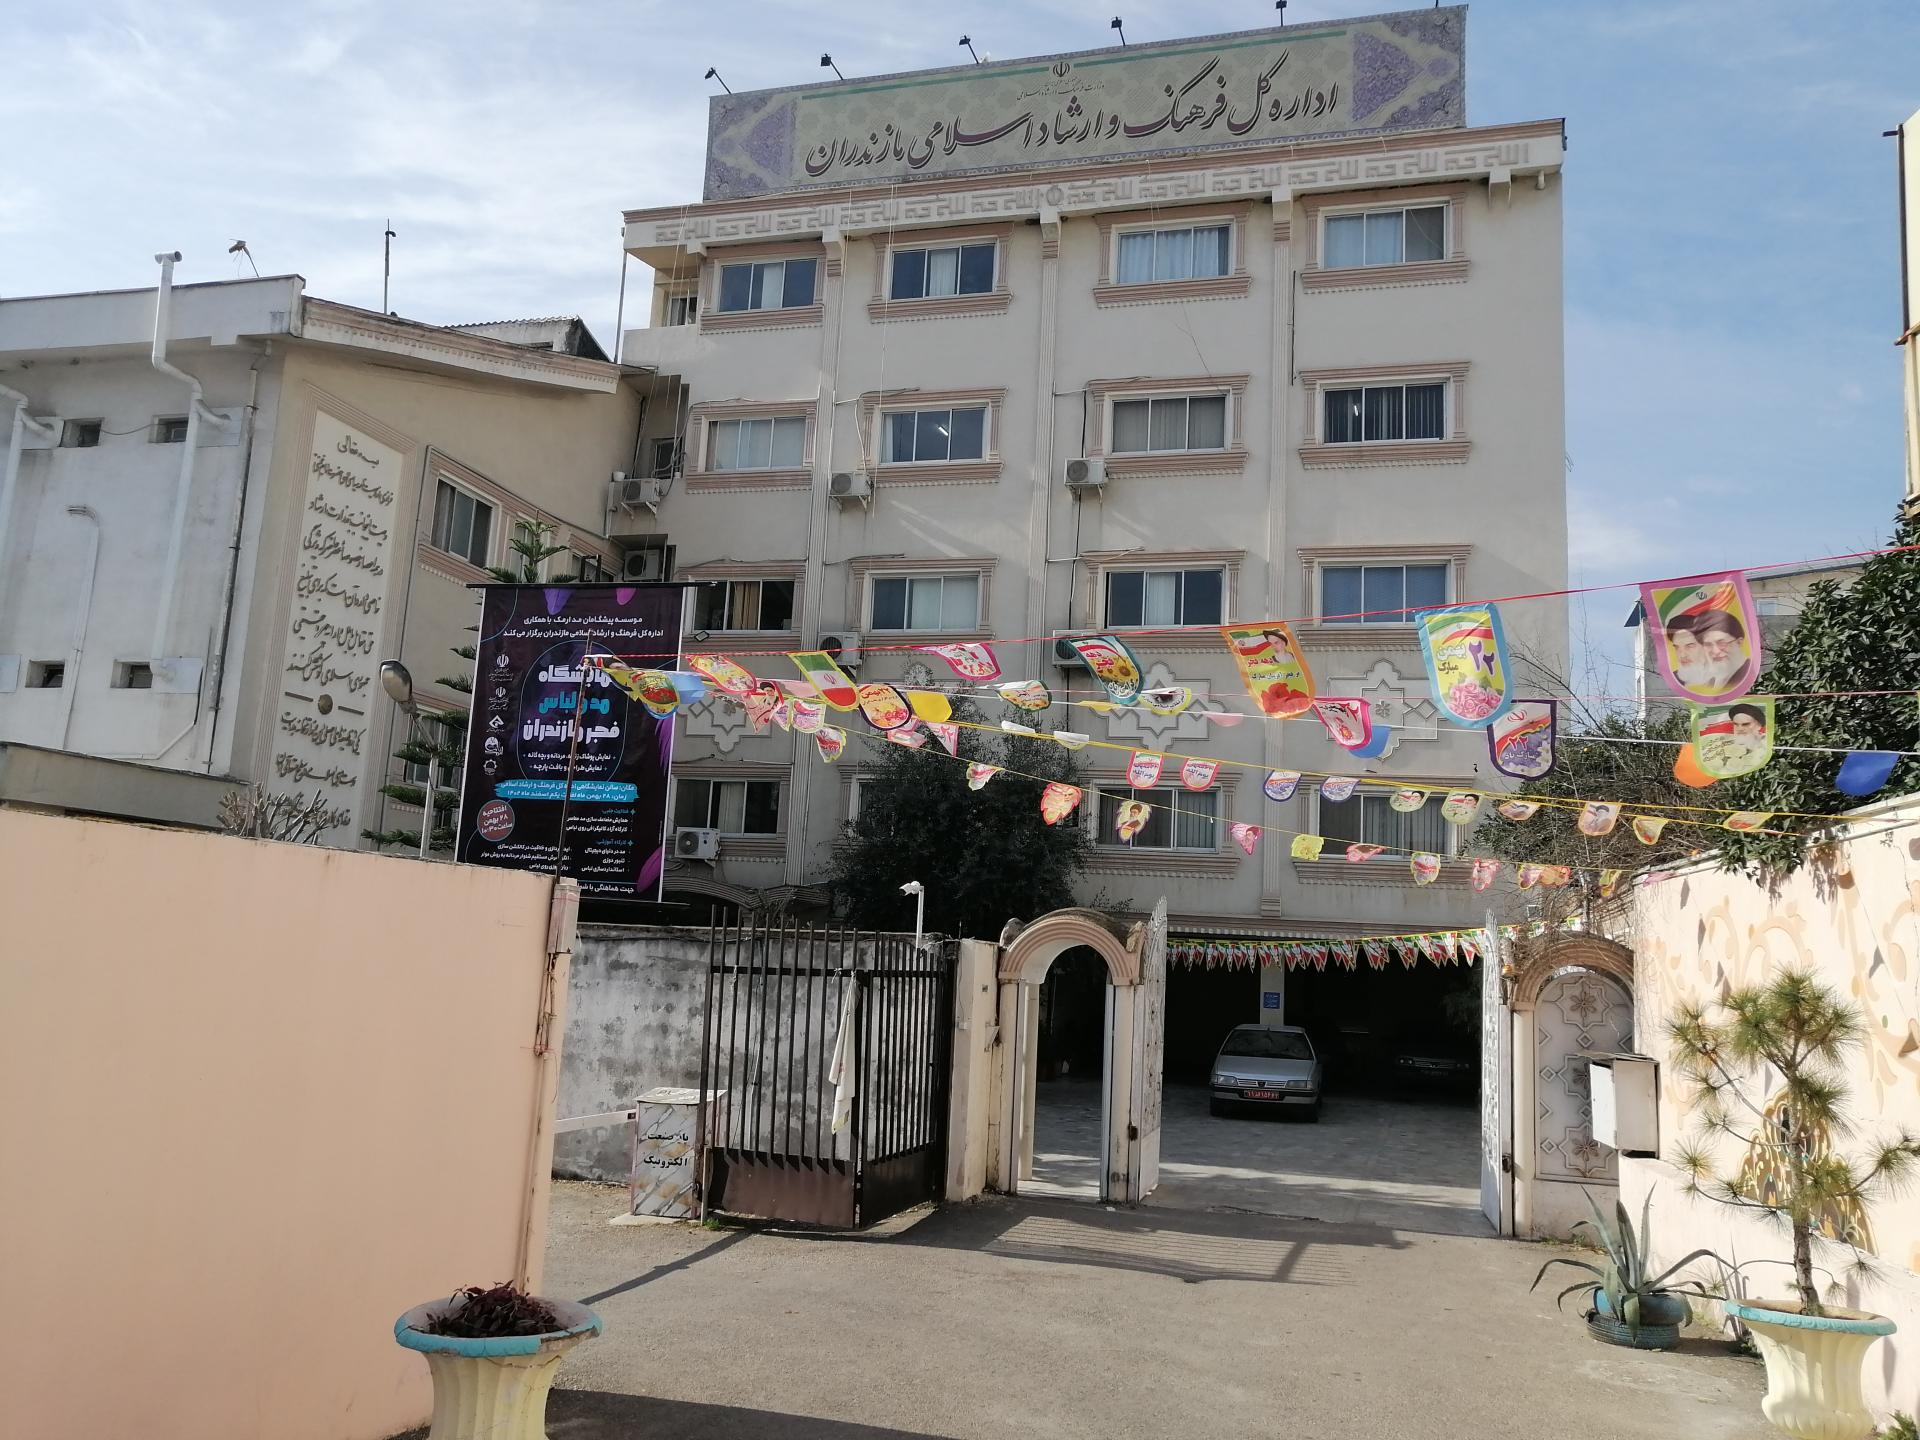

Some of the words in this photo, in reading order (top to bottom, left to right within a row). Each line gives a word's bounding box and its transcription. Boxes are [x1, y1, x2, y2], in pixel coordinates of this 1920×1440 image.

[1227, 48, 1289, 135] کل
[1123, 55, 1228, 138] فرهنگ
[1269, 81, 1339, 121] اداره
[1036, 95, 1104, 147] ارشاد
[1105, 113, 1121, 139] و
[907, 112, 1034, 169] اسلامی
[804, 123, 904, 176] مازندران
[523, 617, 547, 625] همکاری
[547, 617, 552, 625] با
[553, 616, 570, 624] ارمک
[583, 616, 615, 626] پیشگامان
[615, 616, 643, 625] موسسه
[503, 629, 516, 638] کند
[526, 629, 543, 638] برگزار
[543, 629, 569, 637] مازندران
[592, 629, 610, 637] ارشاد
[615, 629, 637, 637] فرهنگ
[637, 629, 647, 637] کل
[646, 629, 664, 637] اداره
[1437, 644, 1466, 661] بهمن
[1248, 658, 1259, 667] فجر
[1468, 640, 1495, 676] ۲۲
[1437, 662, 1459, 675] مبارک
[538, 664, 612, 688] مایشگاه
[538, 691, 577, 714] لباس
[590, 697, 610, 714] مد
[523, 718, 584, 743] مازندران
[585, 721, 620, 745] فجر
[1508, 736, 1528, 750] ۲۲
[579, 753, 595, 762] پوشاک
[595, 753, 611, 761] نمایش
[585, 764, 602, 772] نمایش
[482, 805, 507, 817] افتتاحیه
[483, 817, 499, 826] بهمن
[500, 813, 508, 821] ۲۸
[497, 822, 513, 830] ساعت
[589, 883, 594, 892] با
[594, 884, 619, 892] هماهنگی
[620, 886, 634, 894] جهت
[647, 1132, 673, 1140] صنعت
[643, 1155, 688, 1169] الکترونیک
